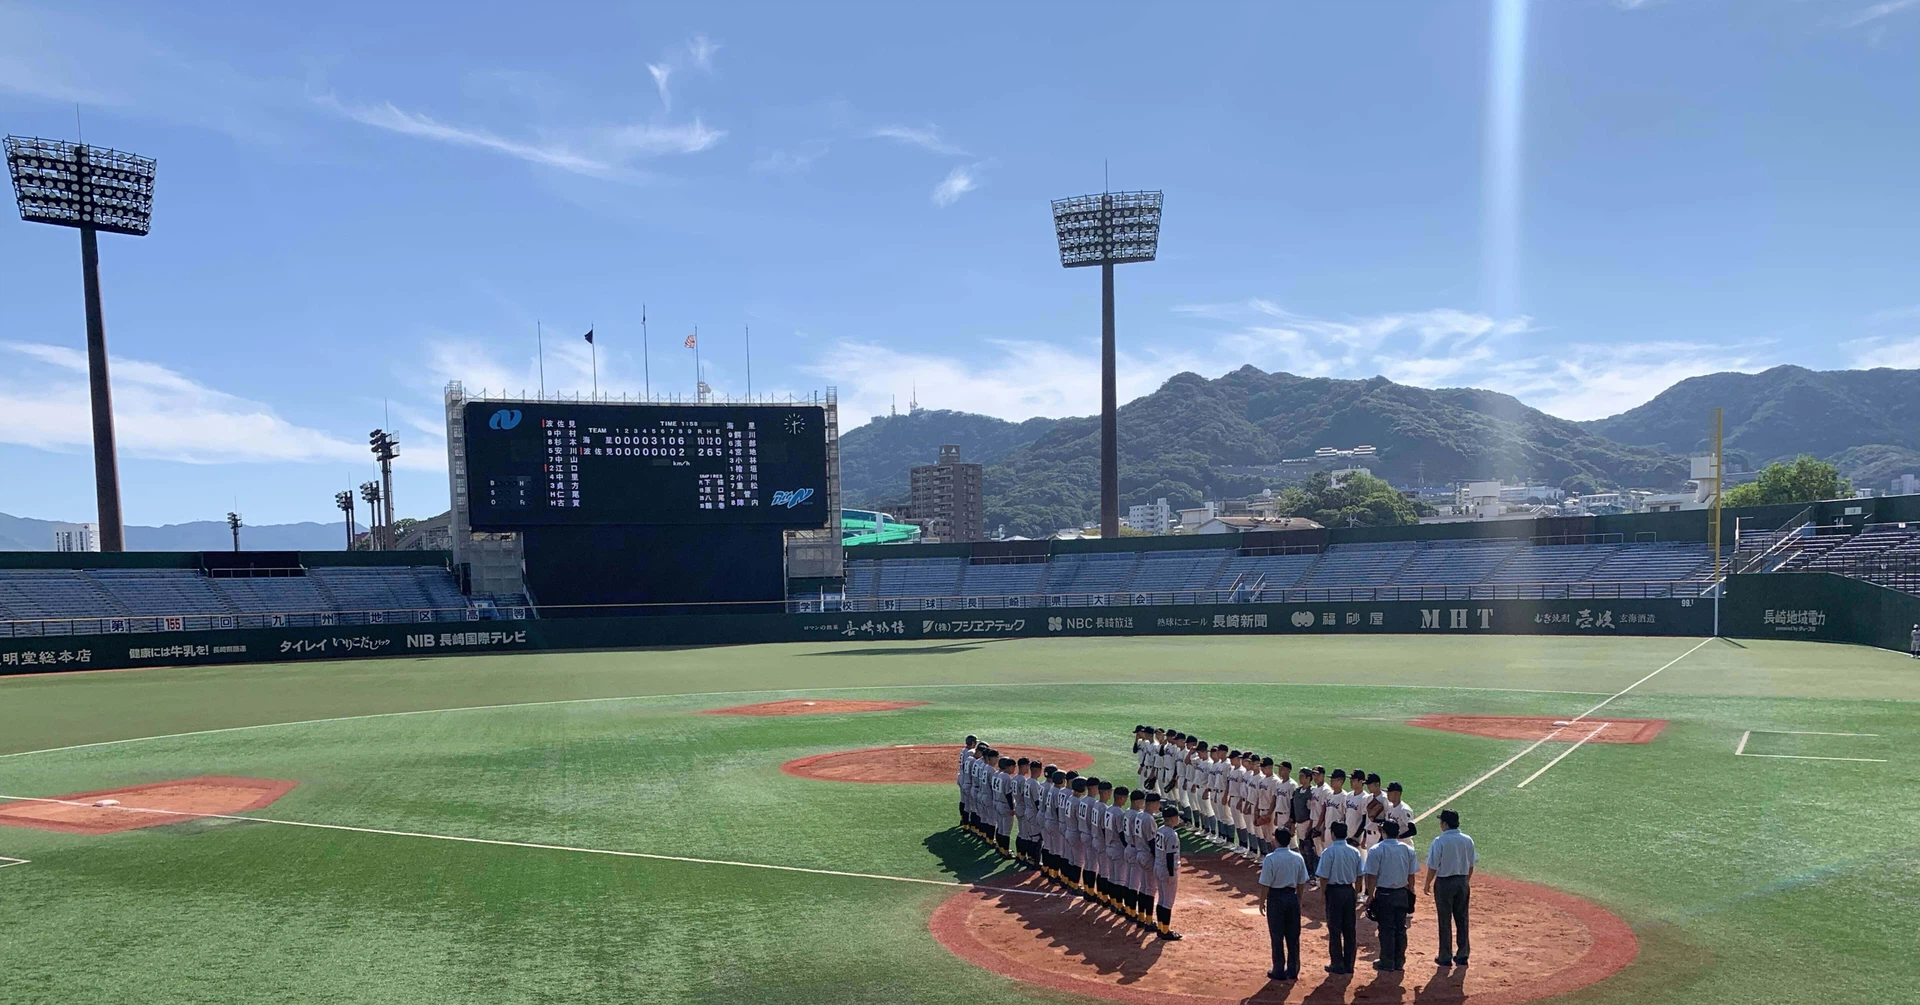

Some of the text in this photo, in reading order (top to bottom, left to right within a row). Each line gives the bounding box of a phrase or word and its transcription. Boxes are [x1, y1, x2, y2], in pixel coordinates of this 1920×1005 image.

[546, 420, 576, 428] 波佐見
[616, 448, 622, 456] 0
[624, 448, 630, 456] 0
[634, 448, 640, 456] 0
[643, 448, 649, 456] 0
[652, 448, 658, 456] 0
[661, 448, 667, 456] 0
[670, 448, 676, 456] 0
[679, 448, 684, 456] 2
[698, 448, 704, 456] 2
[707, 448, 713, 456] 6
[716, 448, 722, 456] 5
[111, 620, 125, 632] 第
[166, 618, 180, 629] 155
[221, 618, 232, 628] 回
[273, 616, 285, 626] 九
[322, 613, 334, 625] 州
[370, 612, 383, 623] 地
[420, 611, 431, 621] 区
[468, 609, 478, 620] 高
[801, 602, 811, 612] 学
[843, 601, 852, 610] 校
[885, 600, 894, 610] 野
[926, 600, 936, 609] 球
[968, 598, 978, 608] 長
[1052, 596, 1061, 605] 県
[1094, 595, 1104, 605] 大
[1136, 594, 1146, 604] 会
[1157, 614, 1268, 628] 熱球にエール 長崎新聞
[1420, 609, 1493, 629] MHT
[1534, 609, 1655, 629] むぎ焼酎 壱岐 玄海酒造
[1764, 609, 1826, 626] 長崎地域電力
[1066, 617, 1134, 629] NBC 長崎放送
[280, 639, 327, 652] タイレイ
[406, 631, 526, 648] NIB 長崎国際テレビ
[0, 649, 92, 665] 明堂総本店
[1156, 832, 1163, 850] 21
